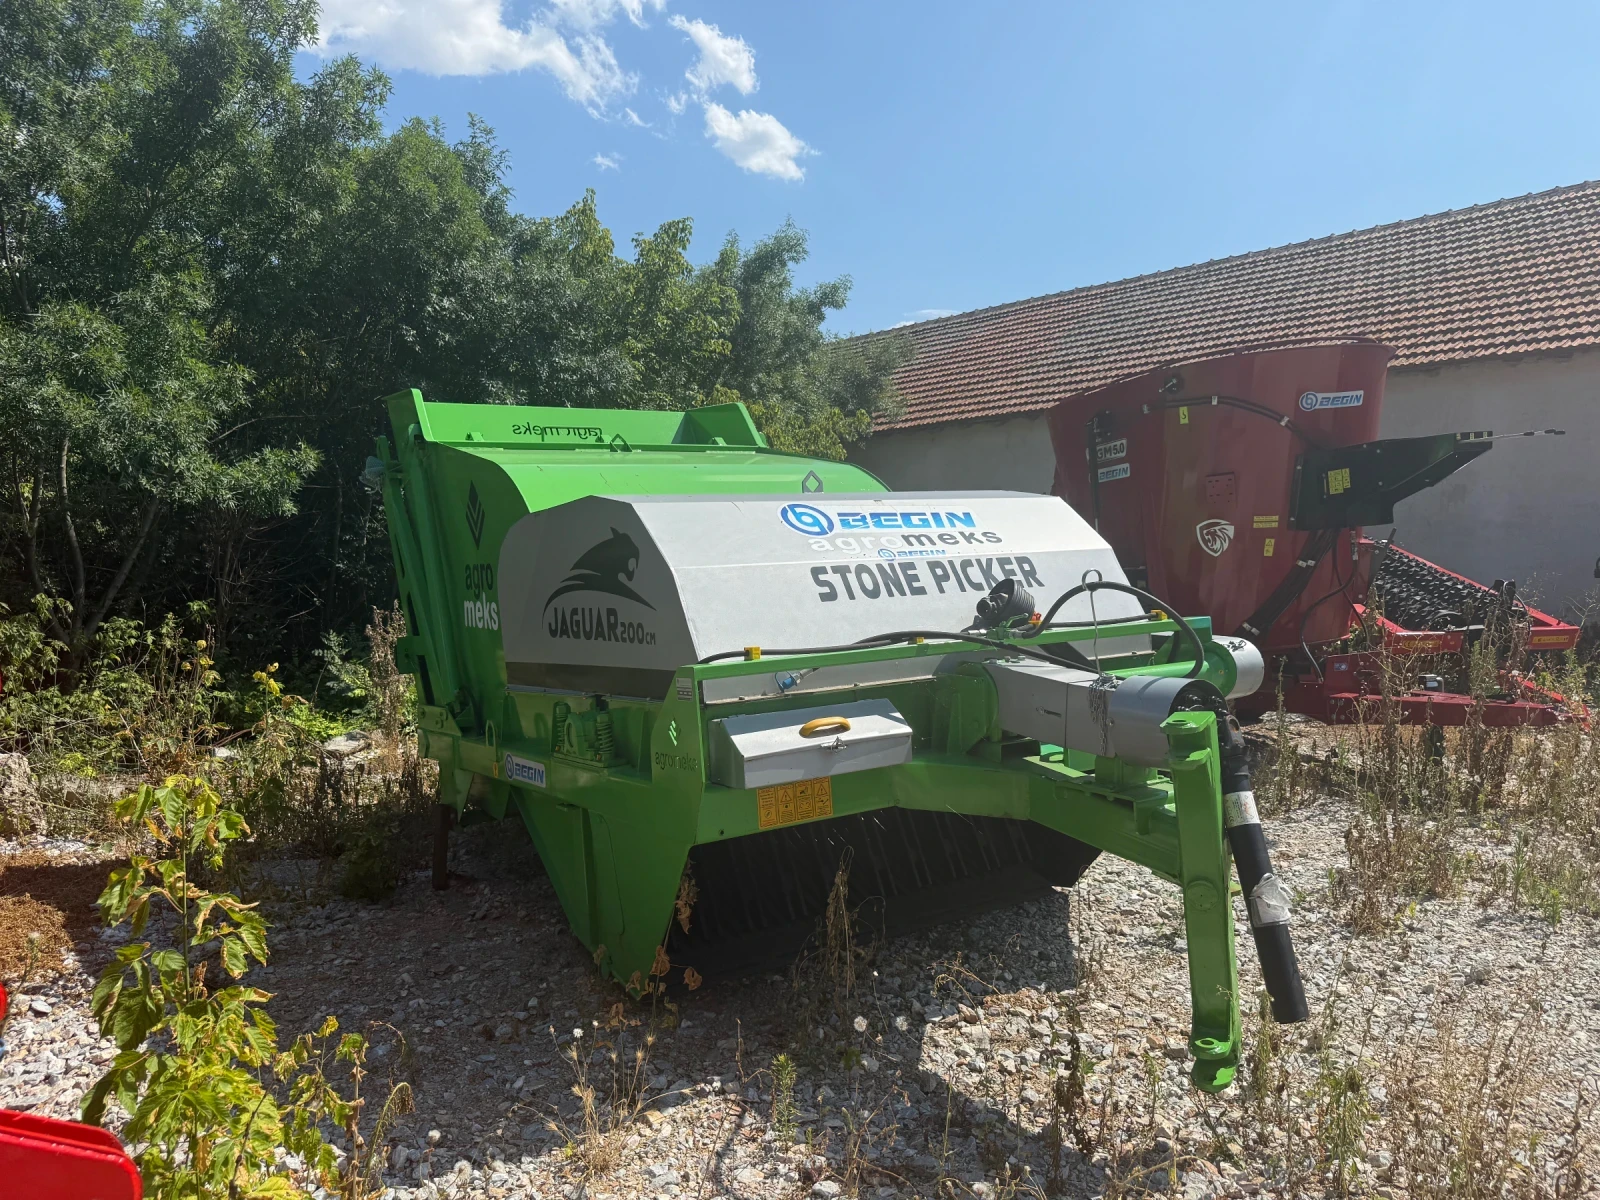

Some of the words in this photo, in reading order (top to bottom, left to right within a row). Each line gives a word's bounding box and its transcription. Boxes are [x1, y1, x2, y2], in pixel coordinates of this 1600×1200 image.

[1319, 394, 1362, 407] BEGIN
[1099, 466, 1129, 481] BEGIN
[837, 512, 976, 529] BEGIN
[808, 531, 1003, 554] agromeks
[896, 549, 946, 557] BEGIN
[464, 563, 494, 600] agro
[810, 561, 928, 602] STONE
[927, 556, 1046, 594] PICKER
[463, 591, 499, 630] meks
[548, 606, 620, 643] JAGUAR
[514, 762, 545, 784] BEGIN
